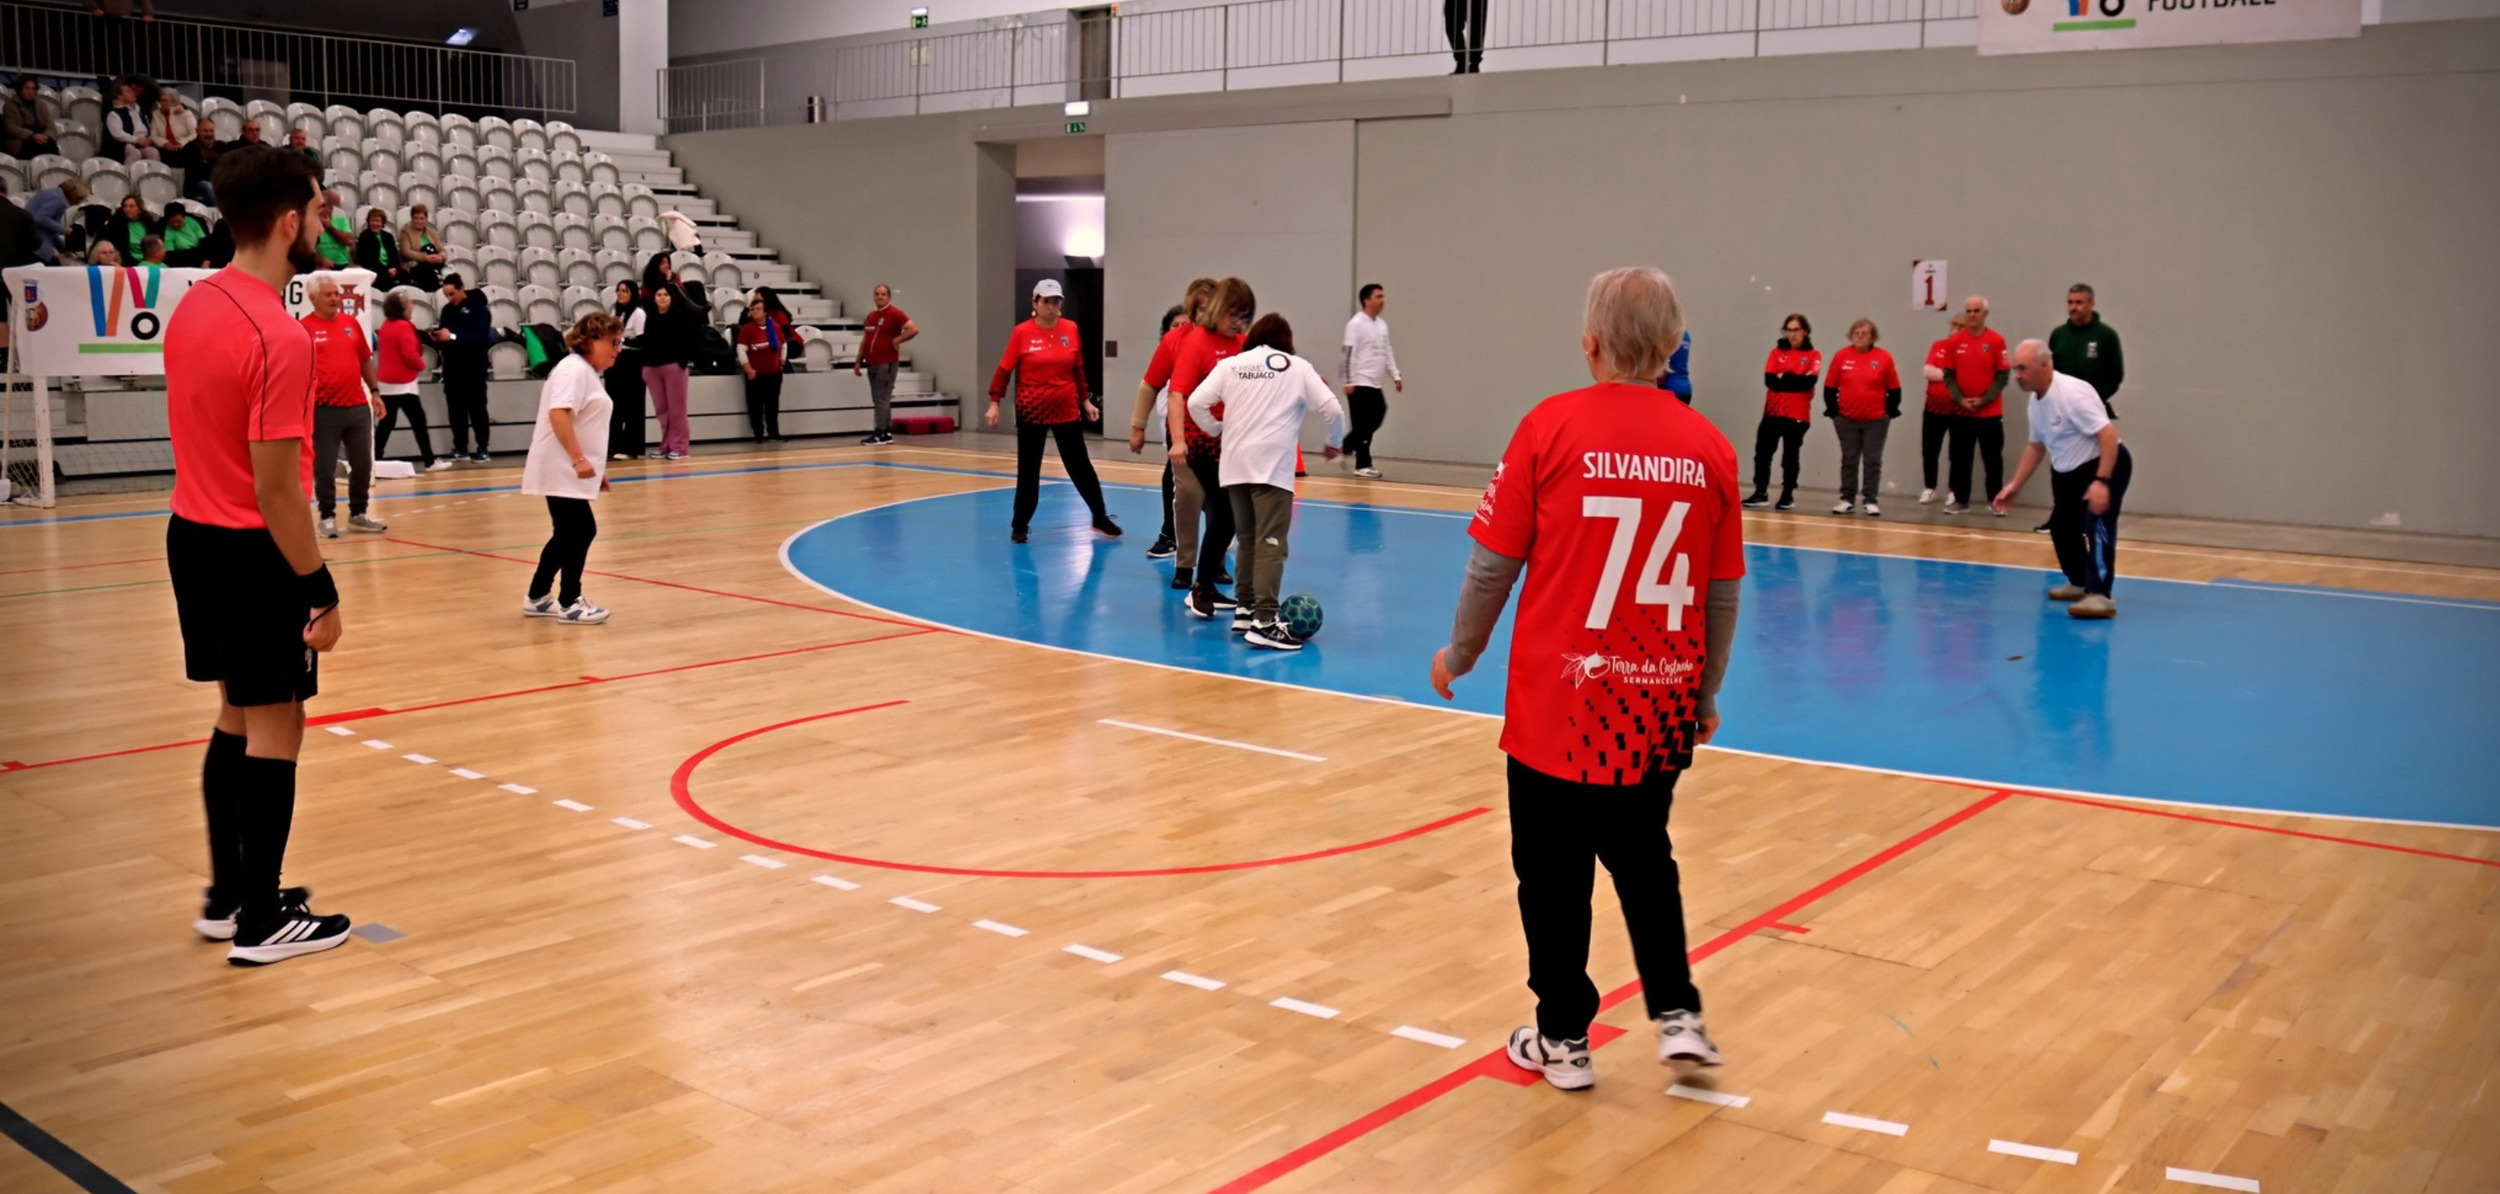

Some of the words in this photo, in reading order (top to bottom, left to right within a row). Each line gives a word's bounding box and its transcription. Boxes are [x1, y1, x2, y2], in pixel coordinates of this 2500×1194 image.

[1925, 274, 1935, 306] 1
[1583, 452, 1706, 488] SILVANDIRA
[1582, 495, 1695, 632] 74
[1609, 656, 1639, 675] Terra
[1641, 659, 1658, 674] da
